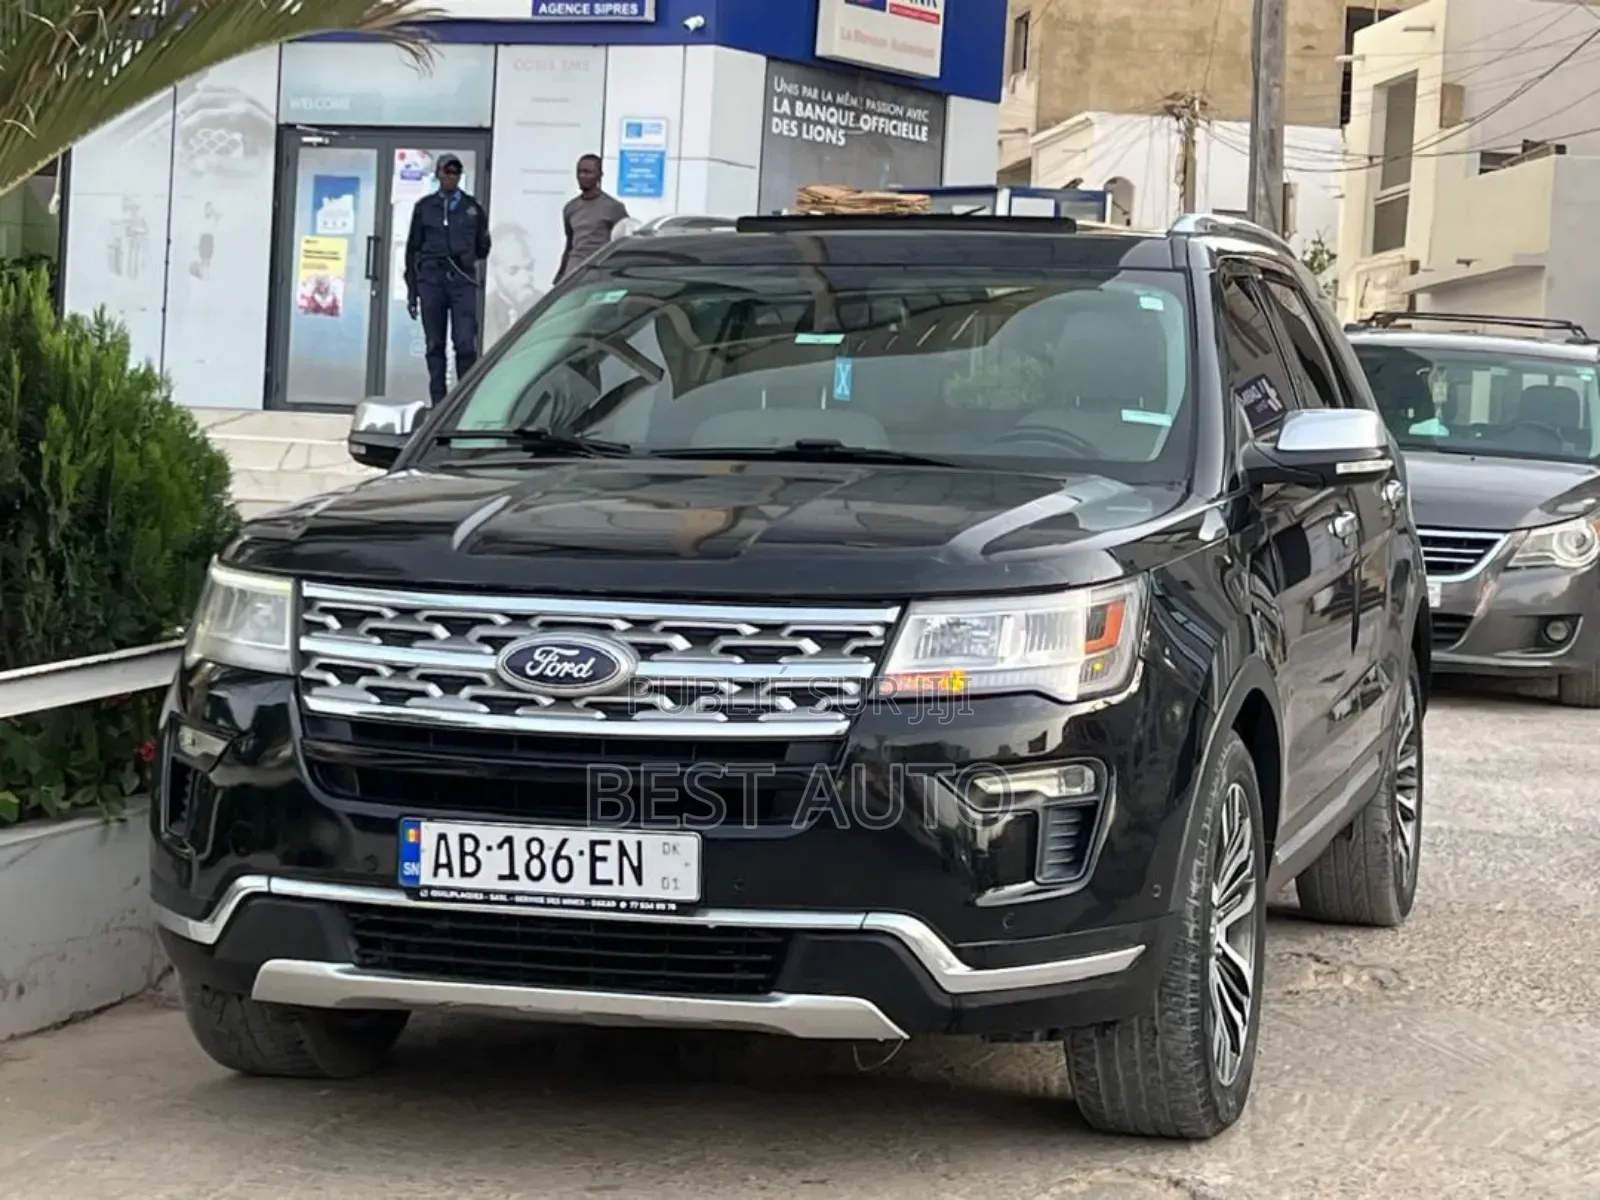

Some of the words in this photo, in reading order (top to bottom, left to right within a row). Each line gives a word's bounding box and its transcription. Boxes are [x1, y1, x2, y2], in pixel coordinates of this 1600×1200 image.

[538, 3, 589, 15] AGENCE
[593, 3, 638, 15] SIPRES
[802, 84, 819, 100] PAR
[821, 88, 833, 103] LA
[866, 98, 905, 117] PASSION
[906, 108, 929, 122] AVEC
[771, 117, 799, 138] DES
[802, 121, 847, 147] LIONS
[772, 96, 792, 116] LA
[794, 100, 857, 128] BANQUE
[860, 113, 929, 142] OFFICIELLE
[525, 646, 596, 679] Ford
[661, 841, 681, 856] DK
[403, 861, 420, 876] SN
